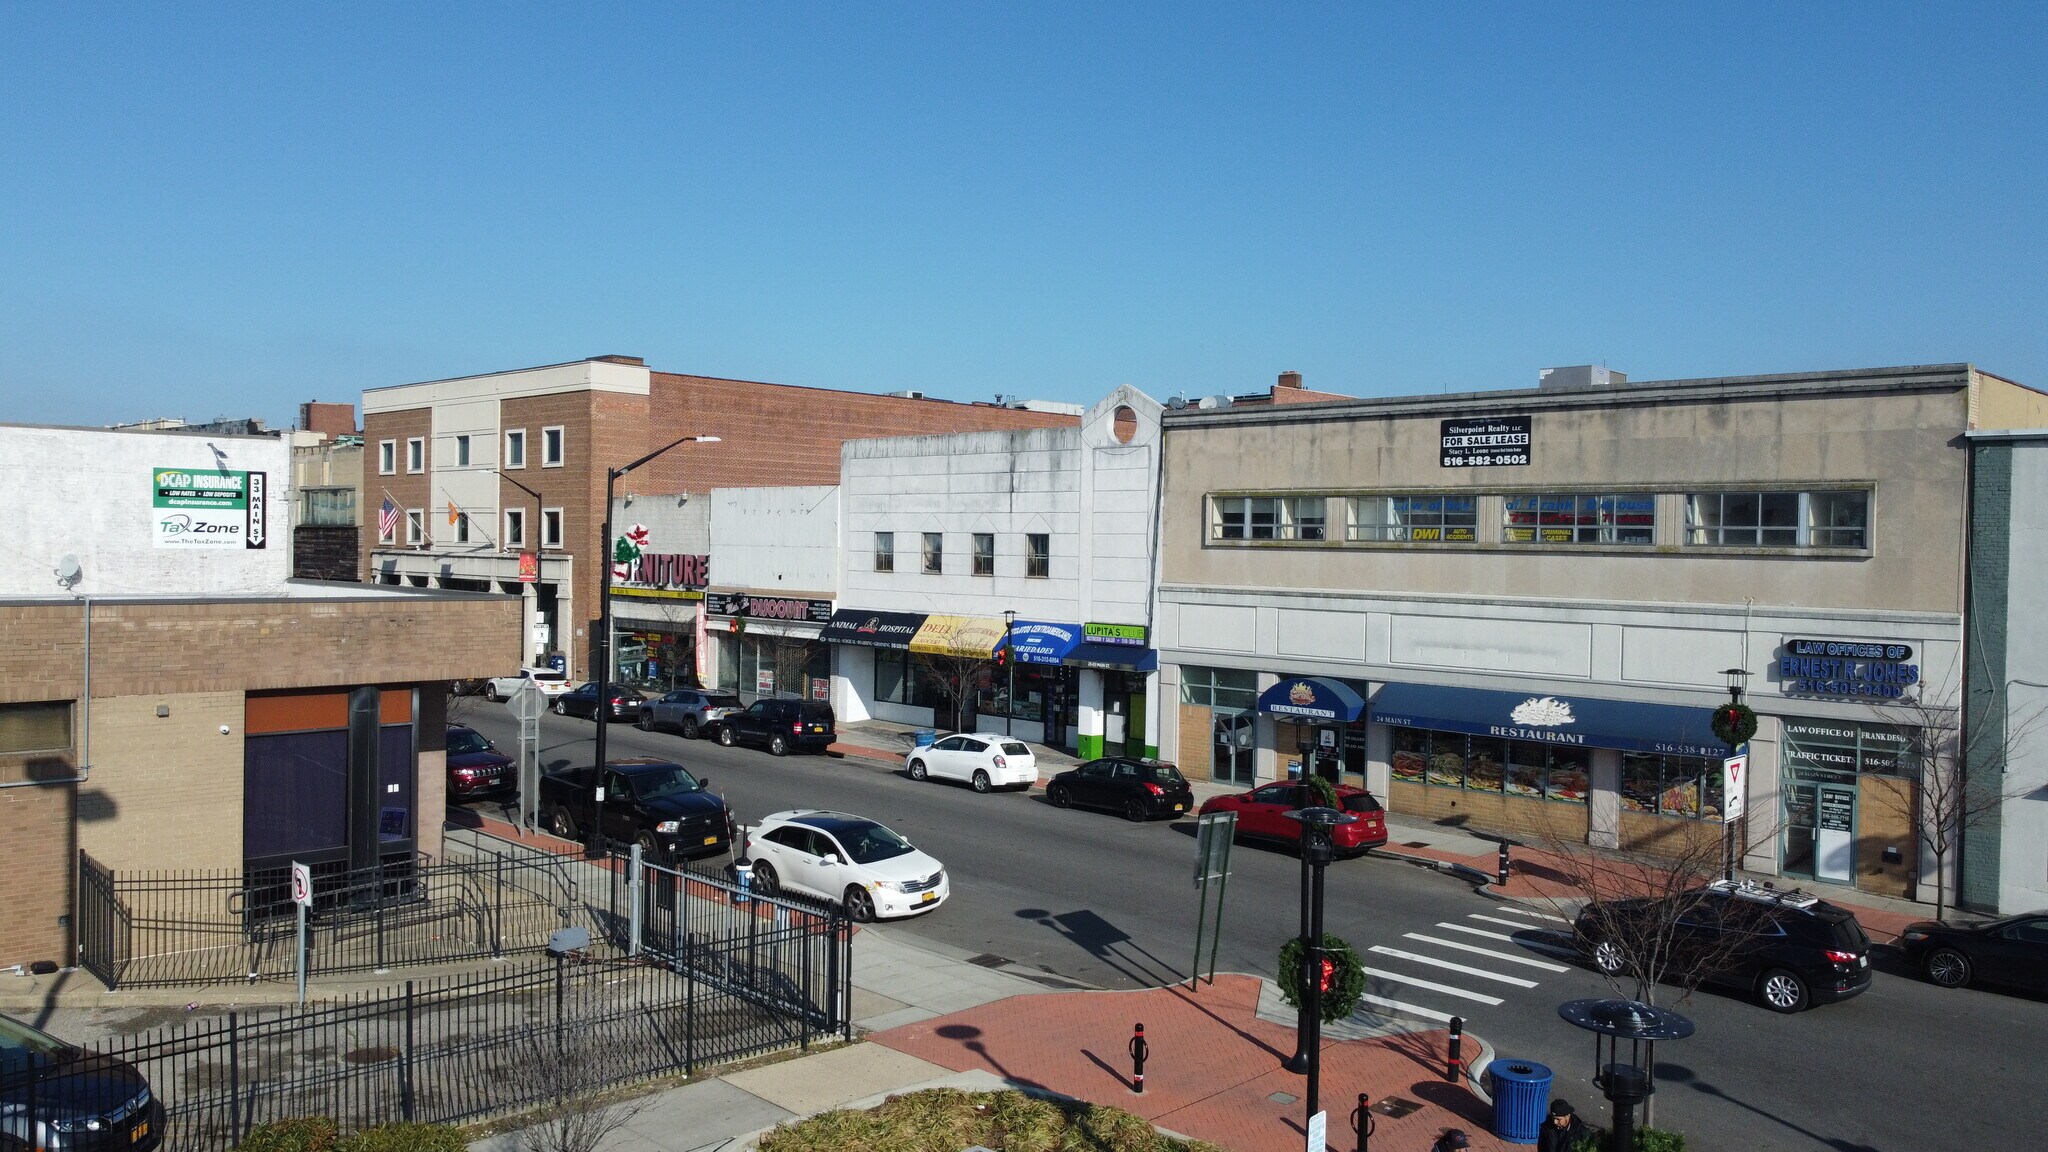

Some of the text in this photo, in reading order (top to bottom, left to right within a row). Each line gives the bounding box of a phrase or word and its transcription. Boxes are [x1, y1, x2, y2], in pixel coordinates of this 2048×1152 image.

[1449, 426, 1485, 434] Silverpoint
[1445, 435, 1527, 446] FOR SALE/LEASE
[1443, 455, 1527, 466] 516-582-0502
[160, 473, 242, 489] DCAP INSURANCE
[252, 496, 261, 525] MAIN
[253, 528, 259, 542] ST
[1413, 528, 1440, 540] DWI
[750, 598, 809, 620] DISCOUNT
[829, 621, 915, 634] ANIMAL HOSPITAL
[922, 623, 953, 635] DELI
[1086, 629, 1144, 639] LUPITA'S CLUB
[1796, 642, 1905, 658] LAW OFFICES OF
[1780, 656, 1919, 684] ERNEST R. JONES
[814, 690, 828, 700] RENT
[1271, 705, 1334, 717] RESTAURANT
[1490, 725, 1586, 744] RESTAURANT
[1787, 725, 1856, 738] LAW OFFICE OF
[1861, 732, 1886, 741] FRANK
[1785, 751, 1856, 764] TRAFFIC TICKETS
